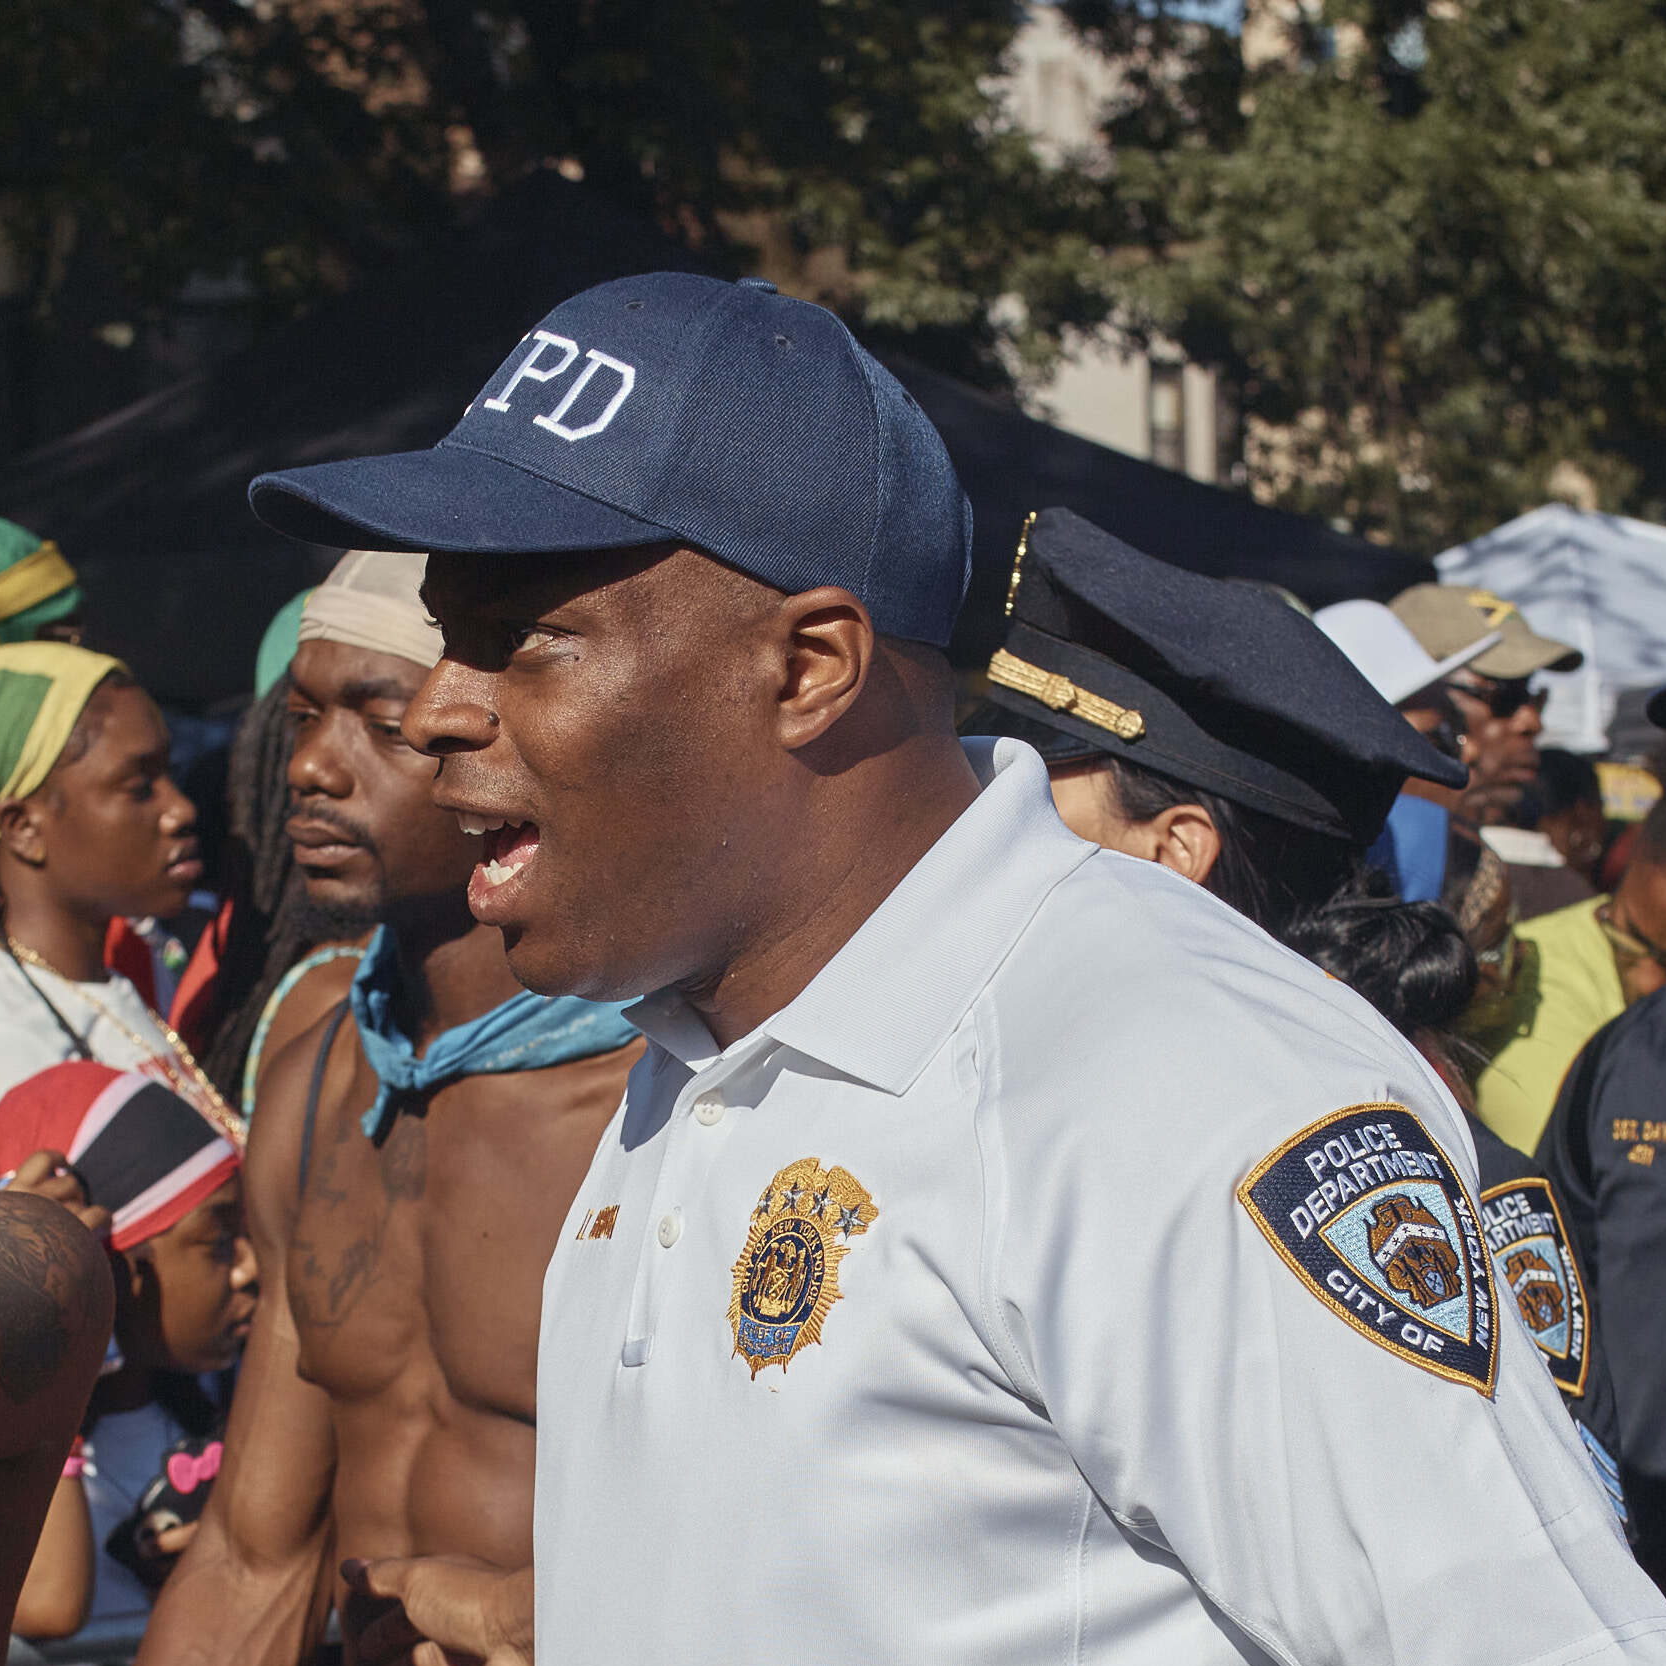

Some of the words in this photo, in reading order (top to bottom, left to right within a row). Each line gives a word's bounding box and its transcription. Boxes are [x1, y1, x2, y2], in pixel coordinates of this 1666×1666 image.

[464, 330, 636, 441] PD
[1304, 1122, 1402, 1183] POLICE
[1289, 1150, 1445, 1240] DEPARTMENT
[771, 1219, 795, 1238] NEW
[798, 1221, 821, 1251] YORK
[1454, 1196, 1486, 1282] YORK
[806, 1250, 824, 1305] POLICE
[1326, 1269, 1397, 1324] CITY
[1401, 1322, 1445, 1353] OF
[1475, 1284, 1490, 1350] NEW
